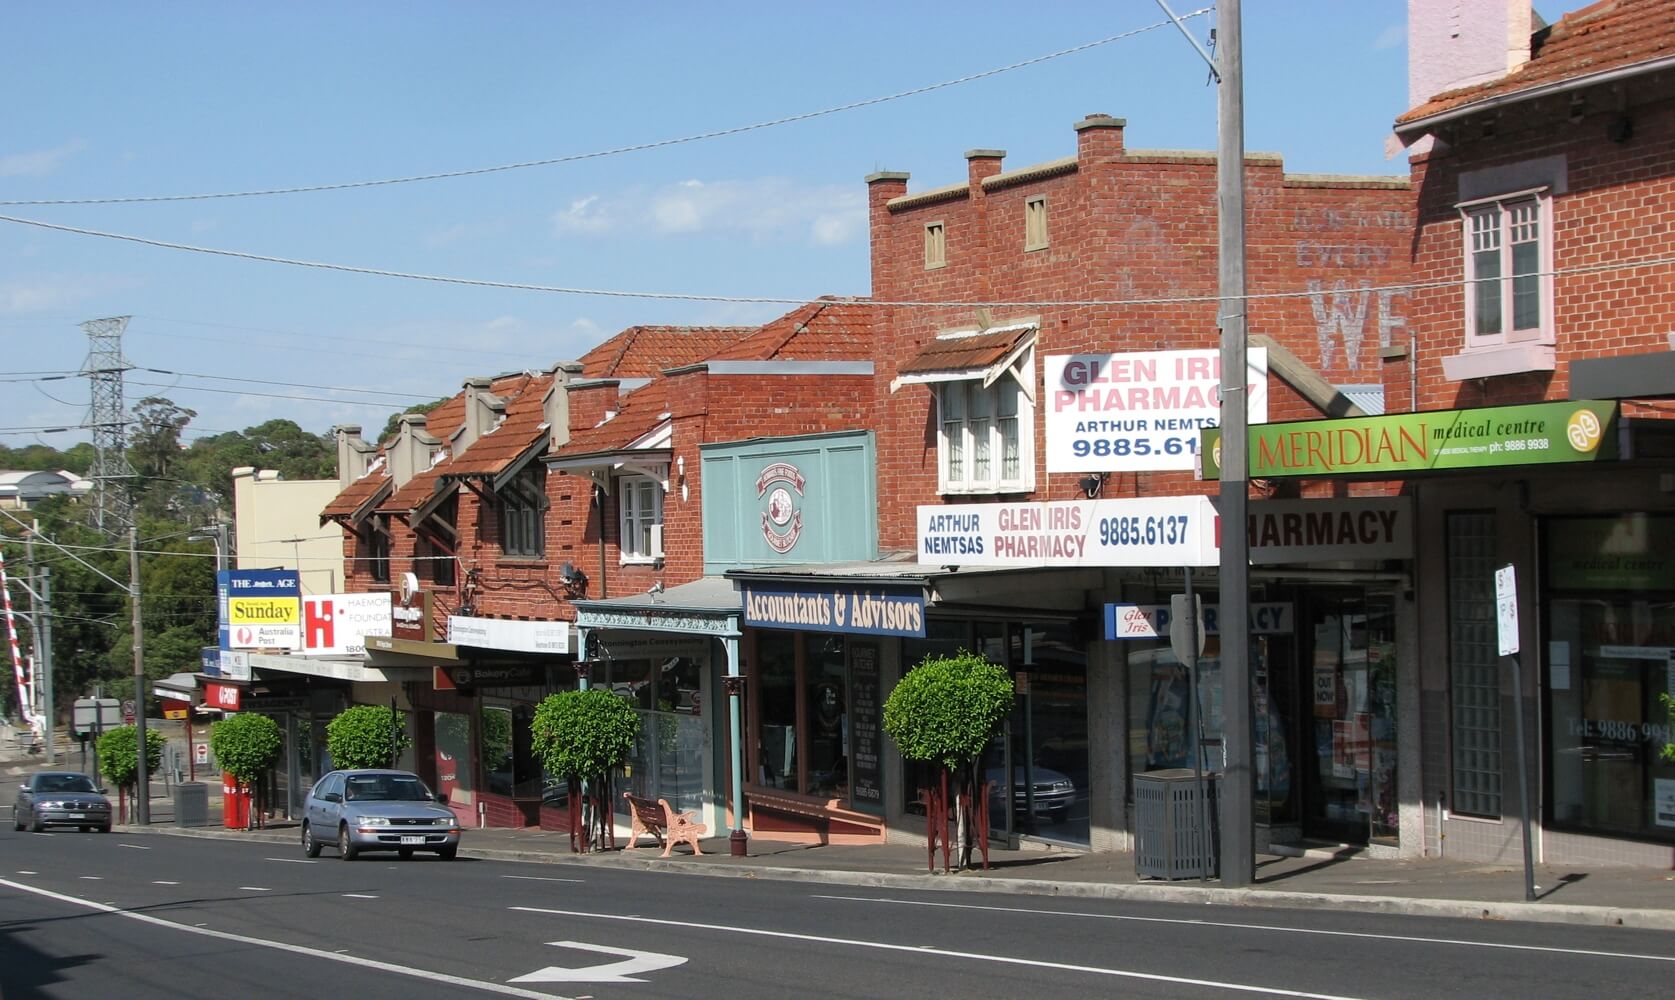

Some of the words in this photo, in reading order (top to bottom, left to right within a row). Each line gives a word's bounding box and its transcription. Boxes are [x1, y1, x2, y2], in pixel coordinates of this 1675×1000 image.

[1063, 359, 1156, 385] GLEN
[1175, 357, 1221, 380] IRI
[1075, 419, 1148, 433] ARTHUR
[1155, 417, 1221, 431] NEMTS
[1433, 419, 1491, 440] medical
[1496, 419, 1545, 436] centre
[1072, 437, 1197, 457] 9885.61
[1256, 423, 1427, 471] MERIDIAN
[1489, 441, 1503, 454] ph:
[1504, 440, 1526, 451] 9886
[1527, 438, 1549, 450] 9938
[928, 513, 980, 533] ARTHUR
[999, 507, 1041, 531] GLEN
[1044, 505, 1081, 530] IRIS
[1099, 515, 1188, 546] 9885.6137
[924, 536, 984, 556] NEMTSAS
[994, 534, 1086, 558] PHARMACY
[231, 579, 251, 588] THE
[276, 579, 296, 588] AGE
[234, 601, 293, 622] Sunday
[746, 587, 831, 626] Accountants
[833, 589, 847, 627] &
[851, 590, 921, 632] Advisors
[1124, 608, 1152, 622] Glen
[258, 627, 293, 636] Australia
[1125, 622, 1148, 634] Iris
[258, 636, 275, 644] Post
[1318, 677, 1331, 689] OUT
[224, 687, 238, 705] POST
[1317, 692, 1333, 702] NOW
[1567, 718, 1593, 737] Tel:
[1598, 719, 1636, 741] 9886
